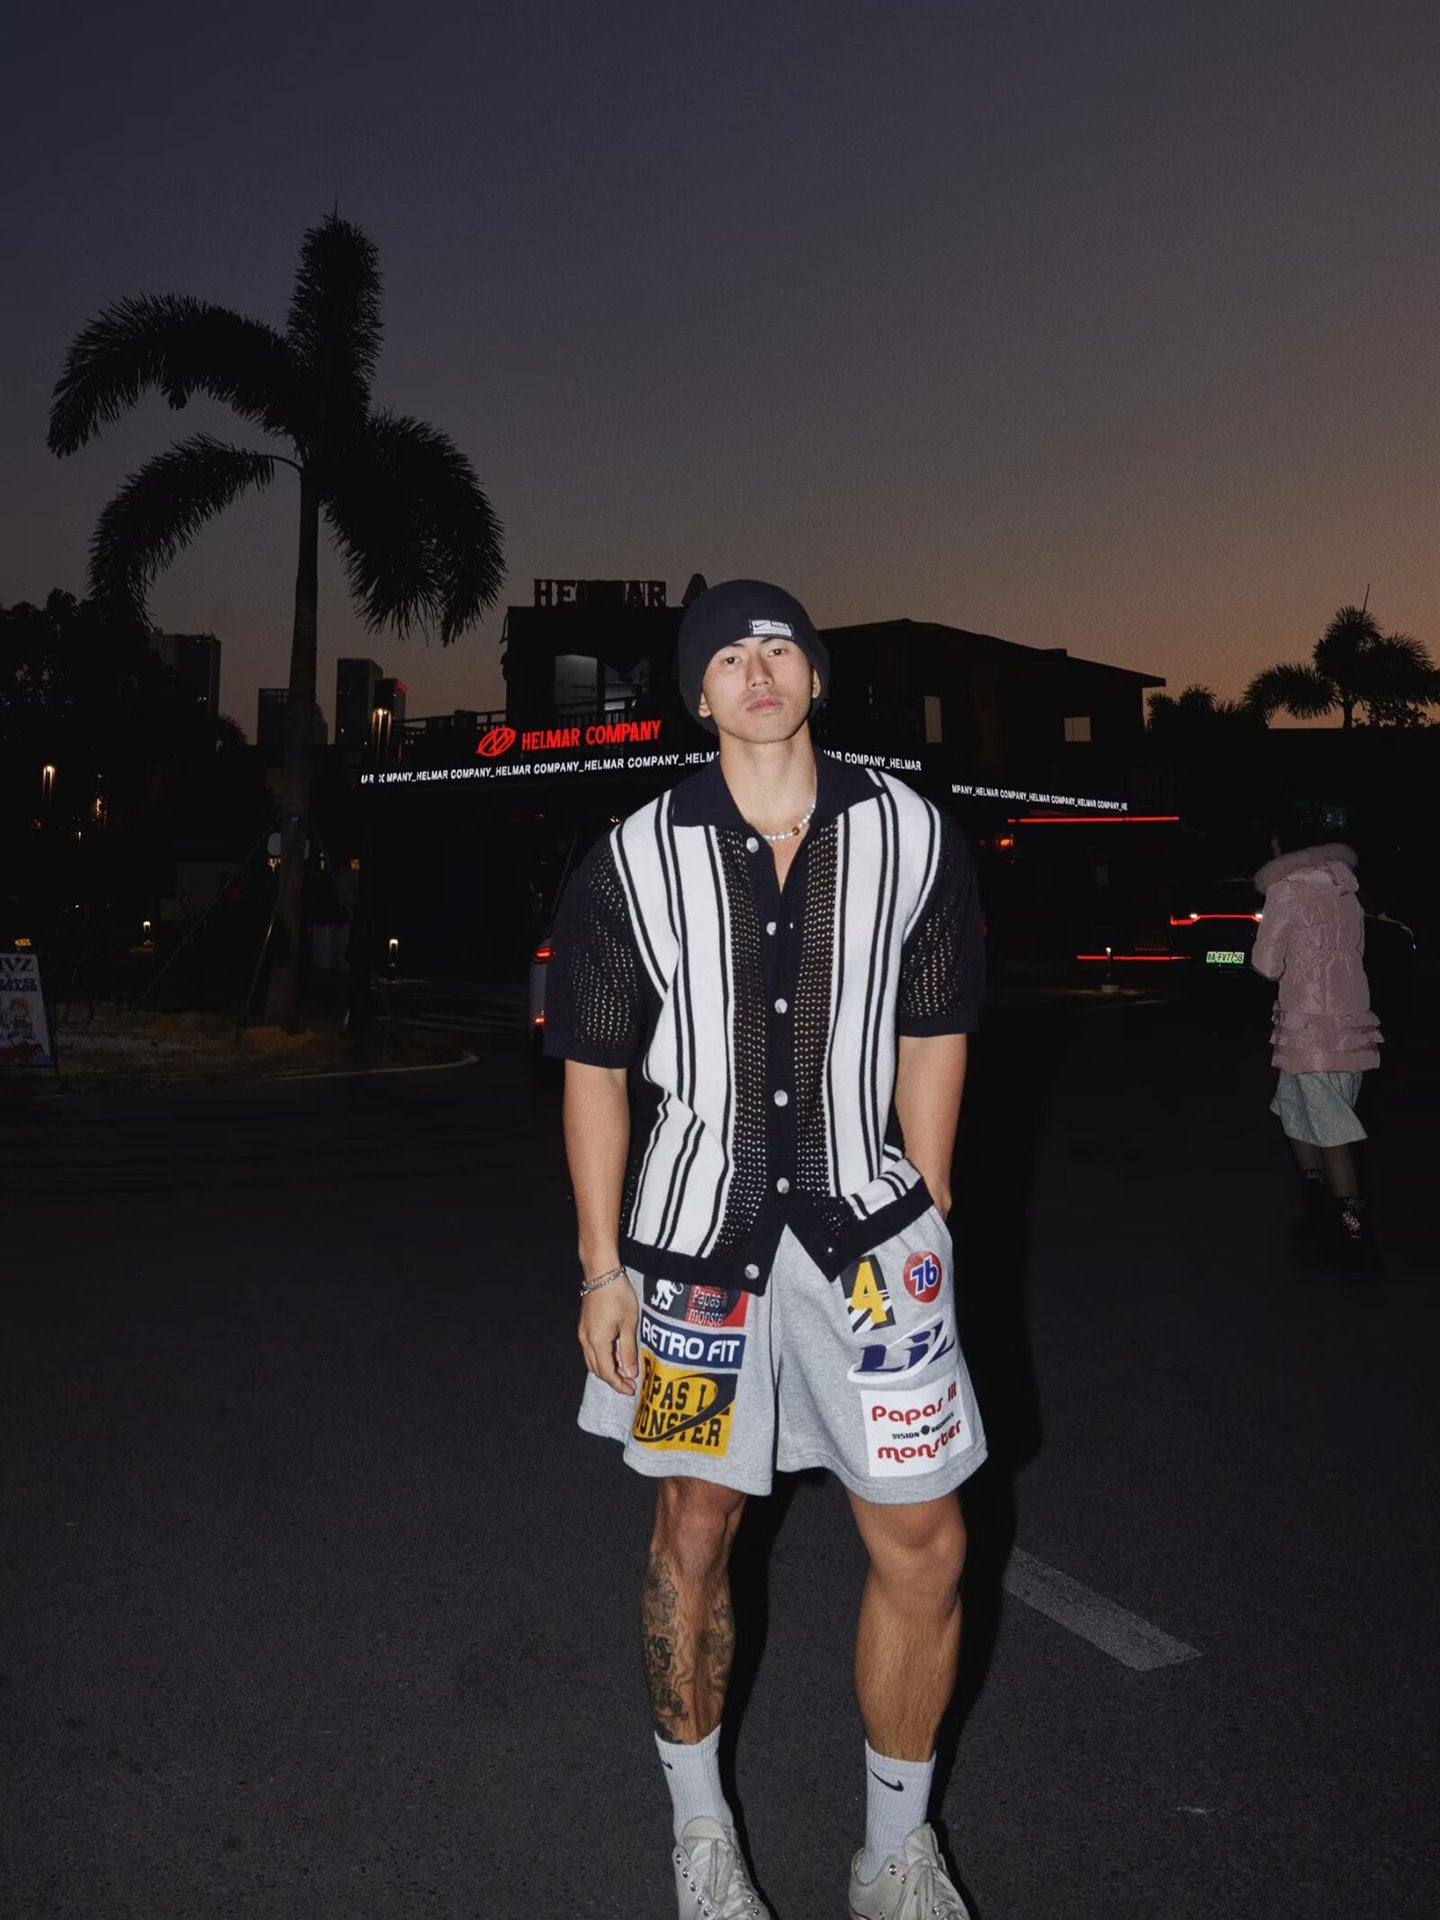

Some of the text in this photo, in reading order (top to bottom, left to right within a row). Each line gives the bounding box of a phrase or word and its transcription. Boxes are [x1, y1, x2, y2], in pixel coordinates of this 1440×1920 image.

[522, 720, 660, 750] HELMAR COMPANY
[628, 751, 719, 768] COMPANY_HELM
[911, 1258, 938, 1293] 76
[642, 1316, 740, 1362] RETRO FIT
[871, 1397, 943, 1426] Papas
[877, 1420, 961, 1463] monster
[892, 1432, 920, 1440] VISION
